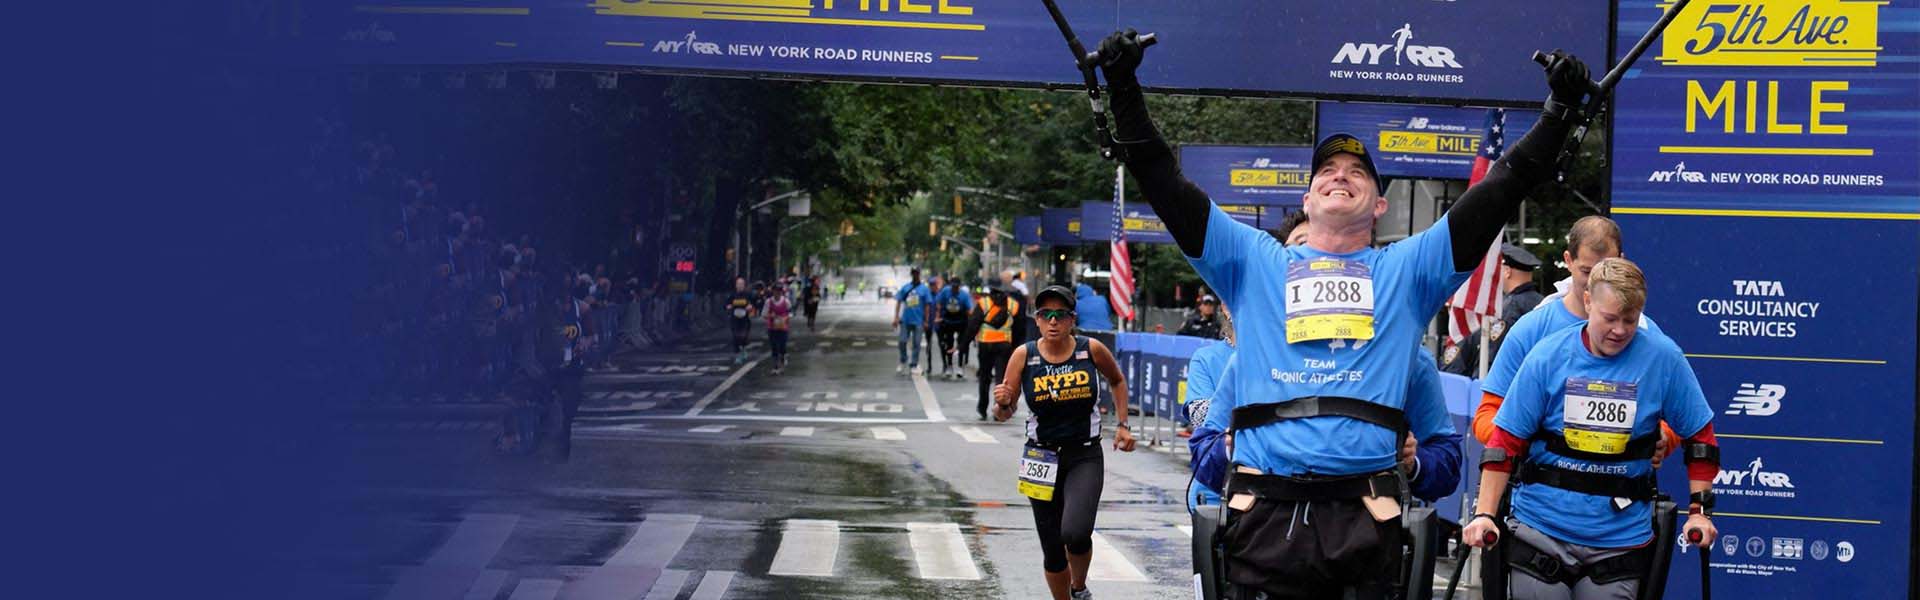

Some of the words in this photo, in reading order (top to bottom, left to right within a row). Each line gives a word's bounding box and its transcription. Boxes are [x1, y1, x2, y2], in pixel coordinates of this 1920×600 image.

[1685, 4, 1768, 55] 5th
[1767, 4, 1848, 45] Ave.
[728, 44, 764, 57] NEW
[768, 45, 810, 59] YORK
[814, 47, 858, 61] ROAD
[862, 50, 933, 63] RUNNERS
[1330, 70, 1354, 78] NEW
[1355, 71, 1383, 80] YORK
[1385, 72, 1414, 81] ROAD
[1416, 73, 1464, 83] RUNNERS
[1686, 80, 1849, 134] MILE
[1440, 137, 1480, 152] MILE
[1280, 173, 1310, 184] MILE
[1711, 172, 1741, 184] NEW
[1745, 173, 1779, 185] YORK
[1783, 174, 1820, 185] ROAD
[1823, 175, 1884, 186] RUNNERS
[1312, 280, 1362, 303] 2888
[1733, 279, 1785, 297] TATA
[1697, 299, 1820, 318] CONSULTANCY
[1719, 320, 1797, 338] SERVICES
[1045, 364, 1074, 377] Yvette
[1304, 358, 1336, 370] TEAM
[1033, 370, 1090, 393] NYPD
[1271, 367, 1308, 384] BIONIC
[1586, 400, 1627, 423] 2886
[1027, 462, 1050, 479] 2587
[1587, 463, 1628, 475] ATHLETES
